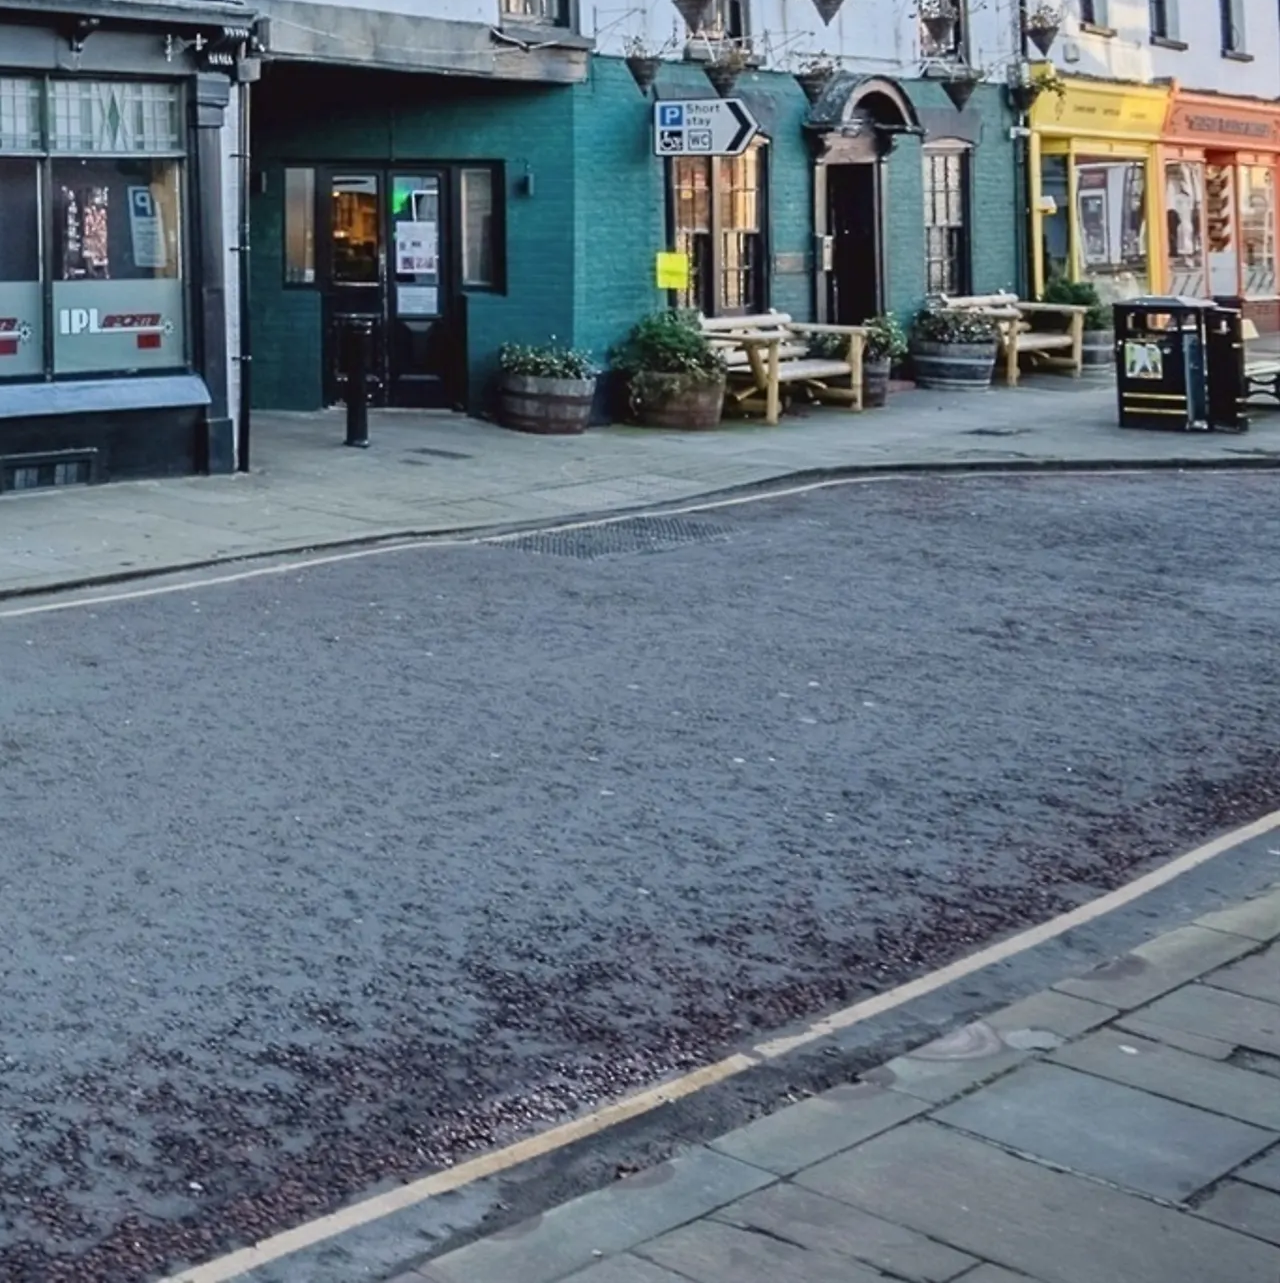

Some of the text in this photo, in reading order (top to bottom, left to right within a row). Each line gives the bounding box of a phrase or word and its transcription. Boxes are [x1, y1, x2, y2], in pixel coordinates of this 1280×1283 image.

[686, 104, 720, 114] Short
[686, 117, 711, 127] stay
[60, 308, 101, 334] IPL
